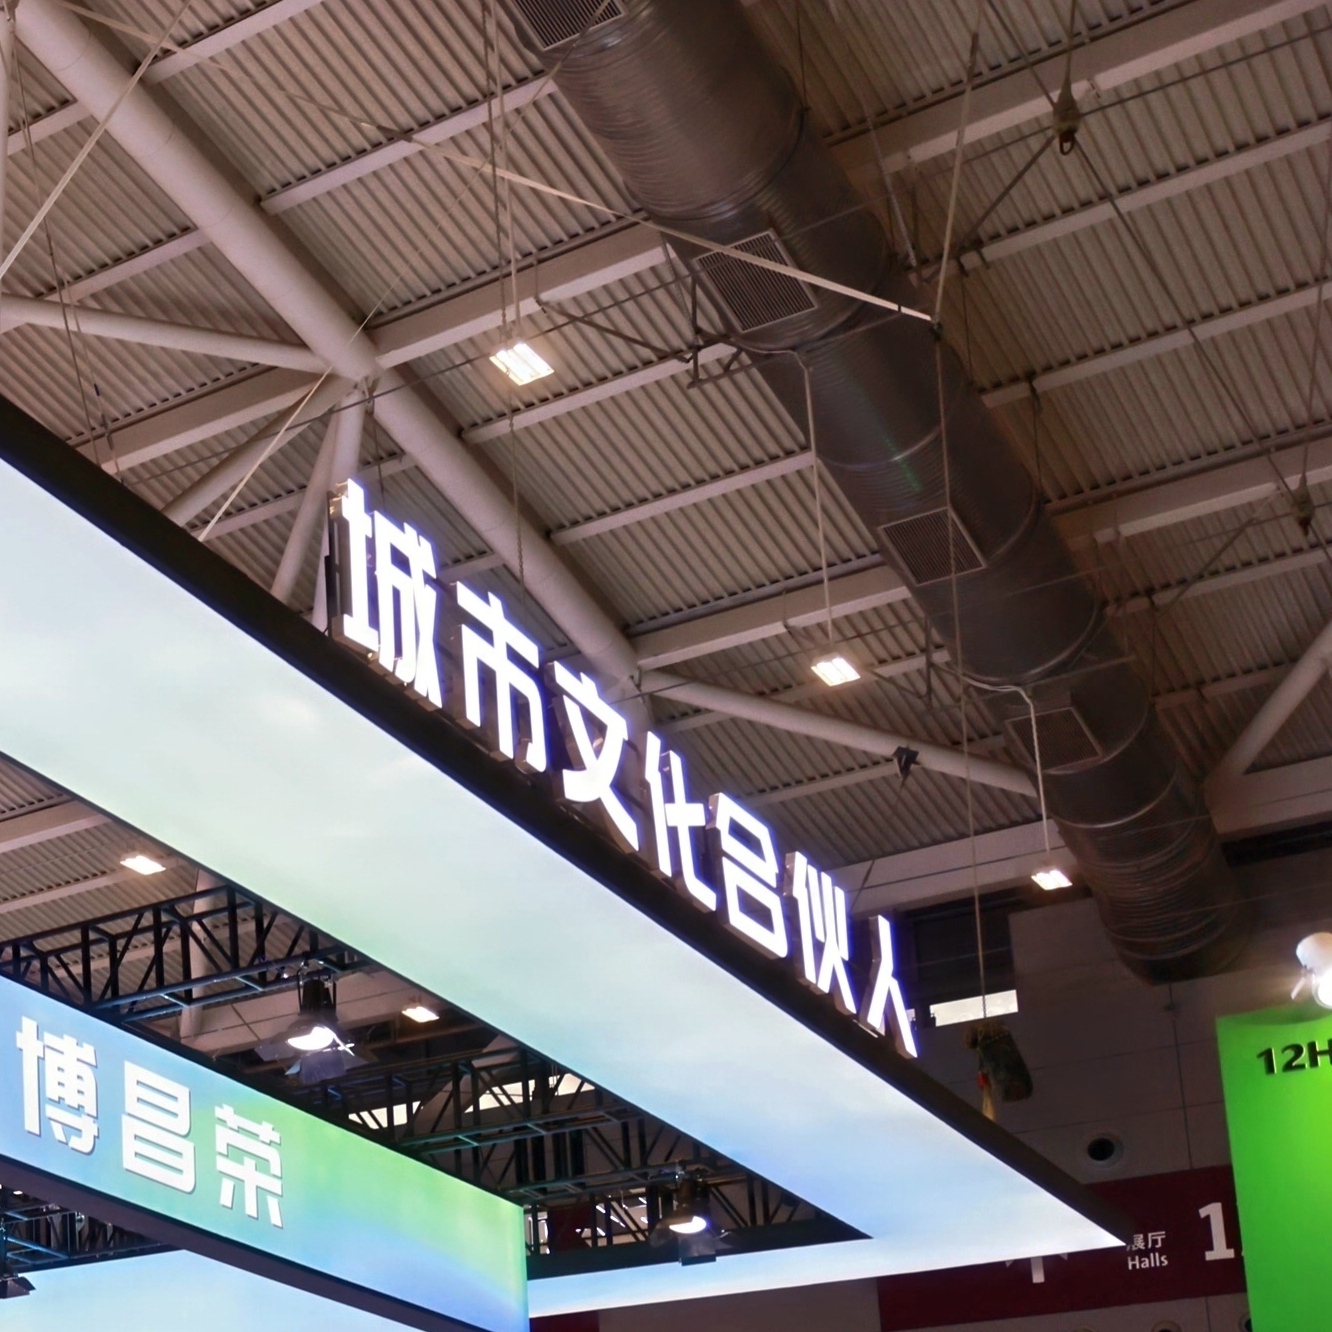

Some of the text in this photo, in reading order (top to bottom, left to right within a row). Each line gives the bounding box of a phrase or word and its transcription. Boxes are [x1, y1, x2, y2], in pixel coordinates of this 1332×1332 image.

[340, 478, 919, 1058] 城市文化合伙人
[1127, 1252, 1168, 1270] Halls
[1198, 1202, 1244, 1261] 1
